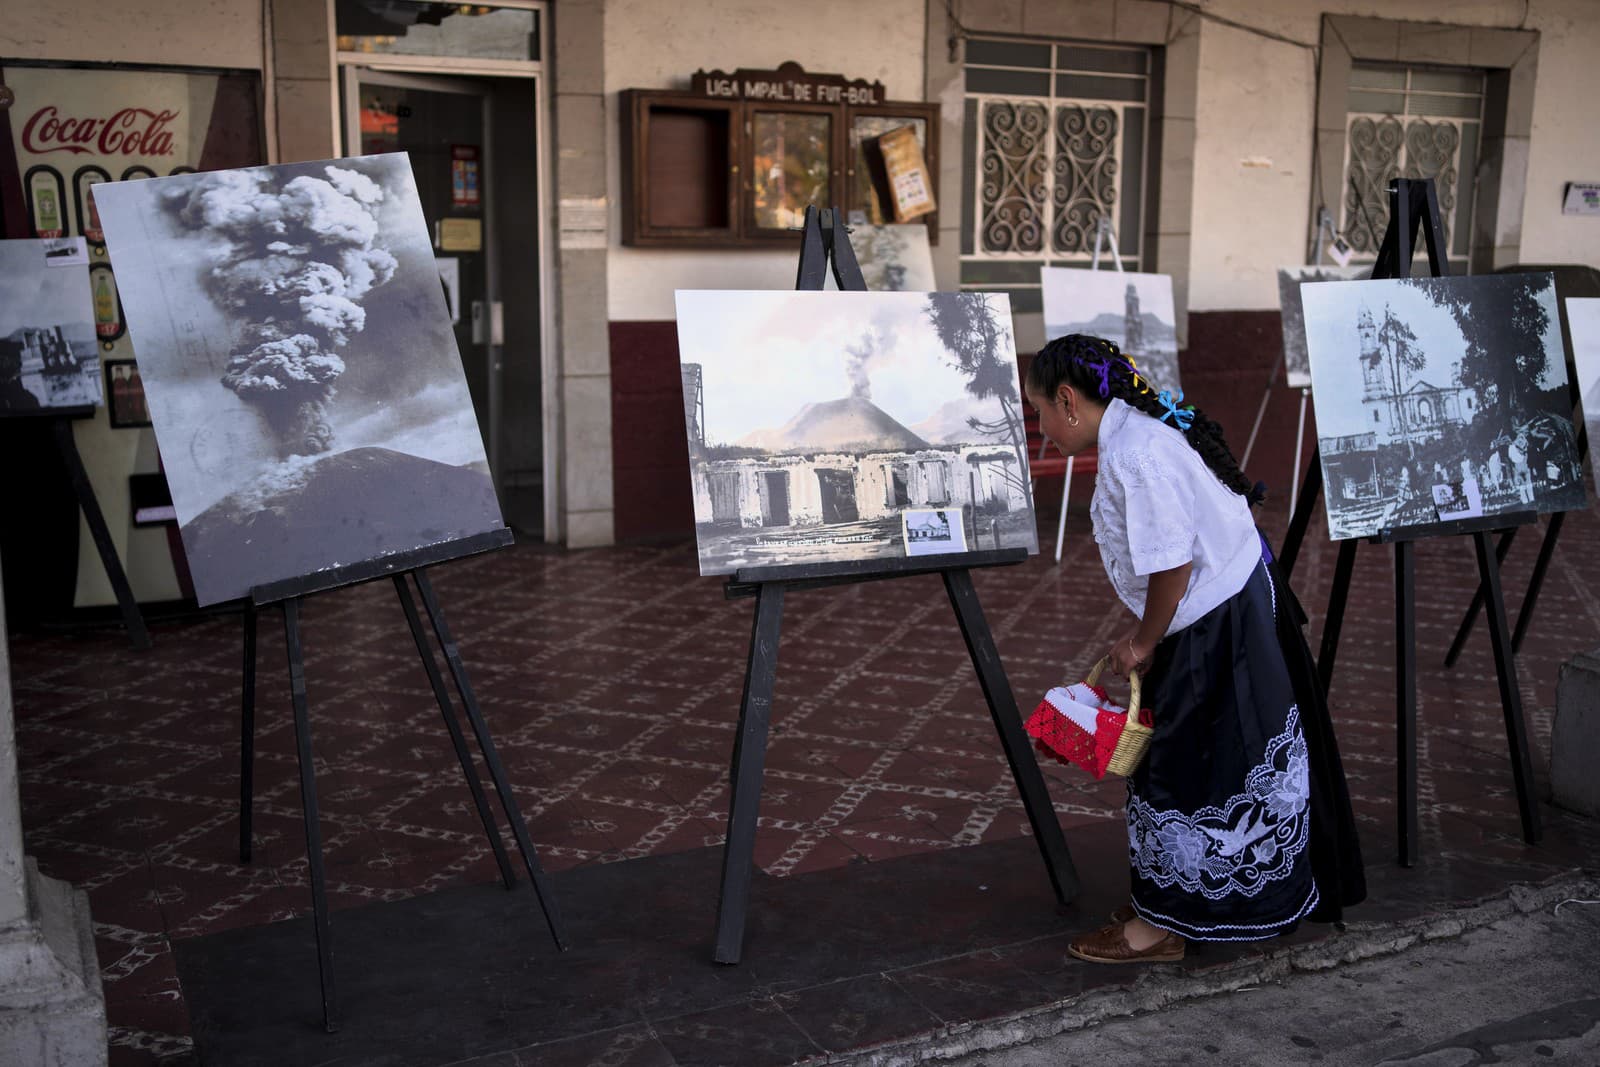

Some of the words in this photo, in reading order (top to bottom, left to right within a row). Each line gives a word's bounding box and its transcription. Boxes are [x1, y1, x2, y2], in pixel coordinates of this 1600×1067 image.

[706, 79, 739, 97] LIGA
[794, 83, 811, 101] DE
[816, 85, 877, 104] FUT-BOL
[22, 106, 180, 155] Coca-Cola
